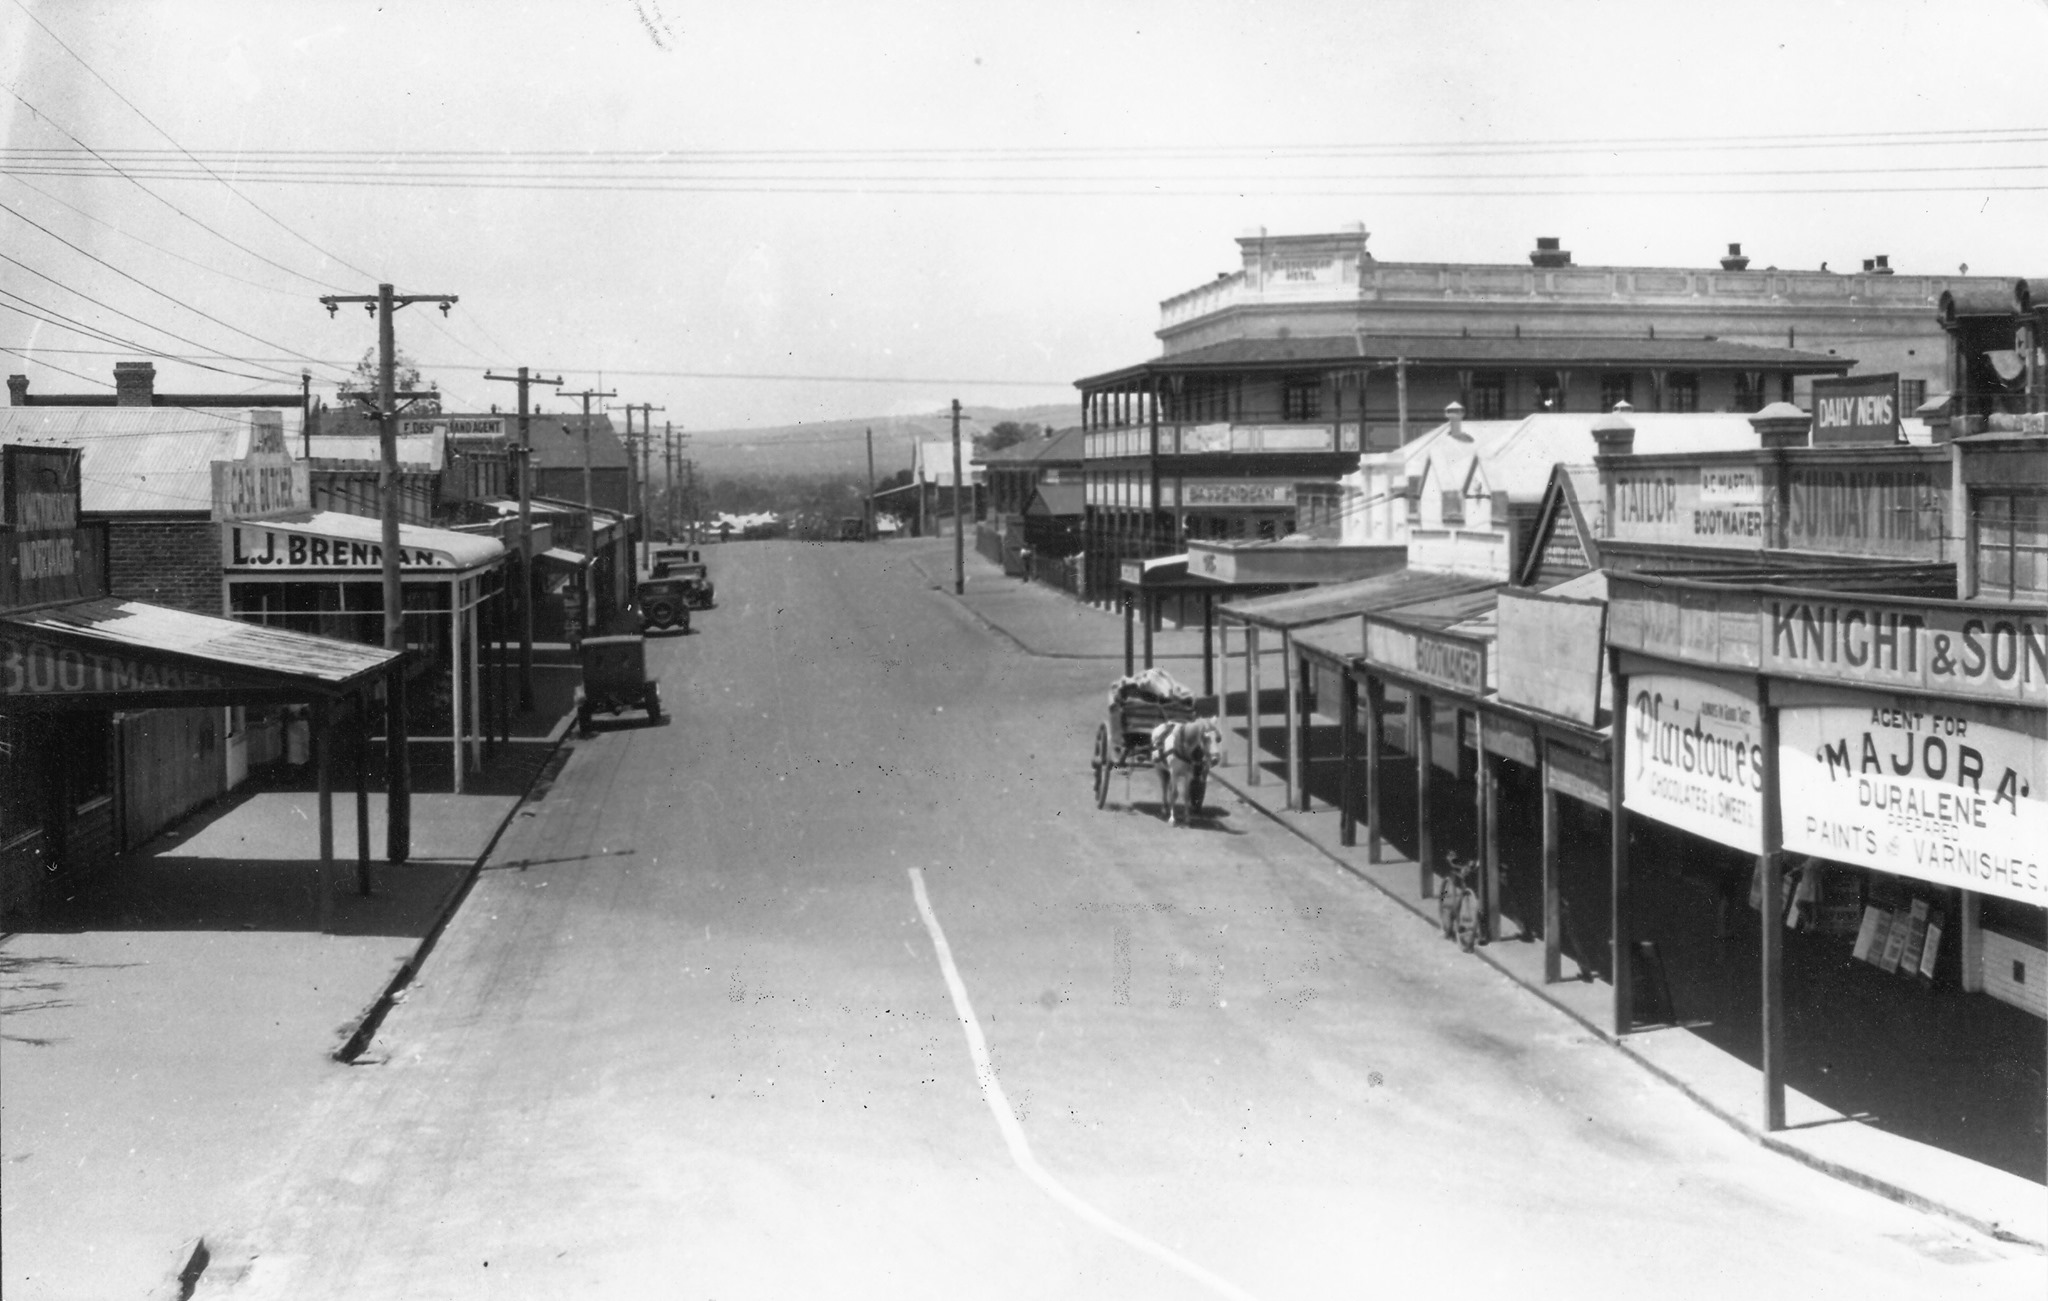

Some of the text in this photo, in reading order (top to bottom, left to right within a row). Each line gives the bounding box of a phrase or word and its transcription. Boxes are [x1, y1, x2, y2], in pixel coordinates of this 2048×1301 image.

[473, 421, 501, 434] AGENT
[1819, 394, 1893, 428] DAILY NEWS
[1618, 476, 1676, 524] TAILOR
[1791, 470, 1873, 538] SUNDAY
[1694, 510, 1761, 536] BOOTMAKER
[1773, 603, 1925, 672] KNIGHT
[1932, 634, 1957, 675] &
[1418, 641, 1479, 686] BOOTMAKER
[1871, 708, 1967, 737] AGENT FOR
[1859, 779, 1987, 829] DURALENE
[1807, 816, 1877, 855] PAINTS
[1888, 814, 1959, 841] PREPARED
